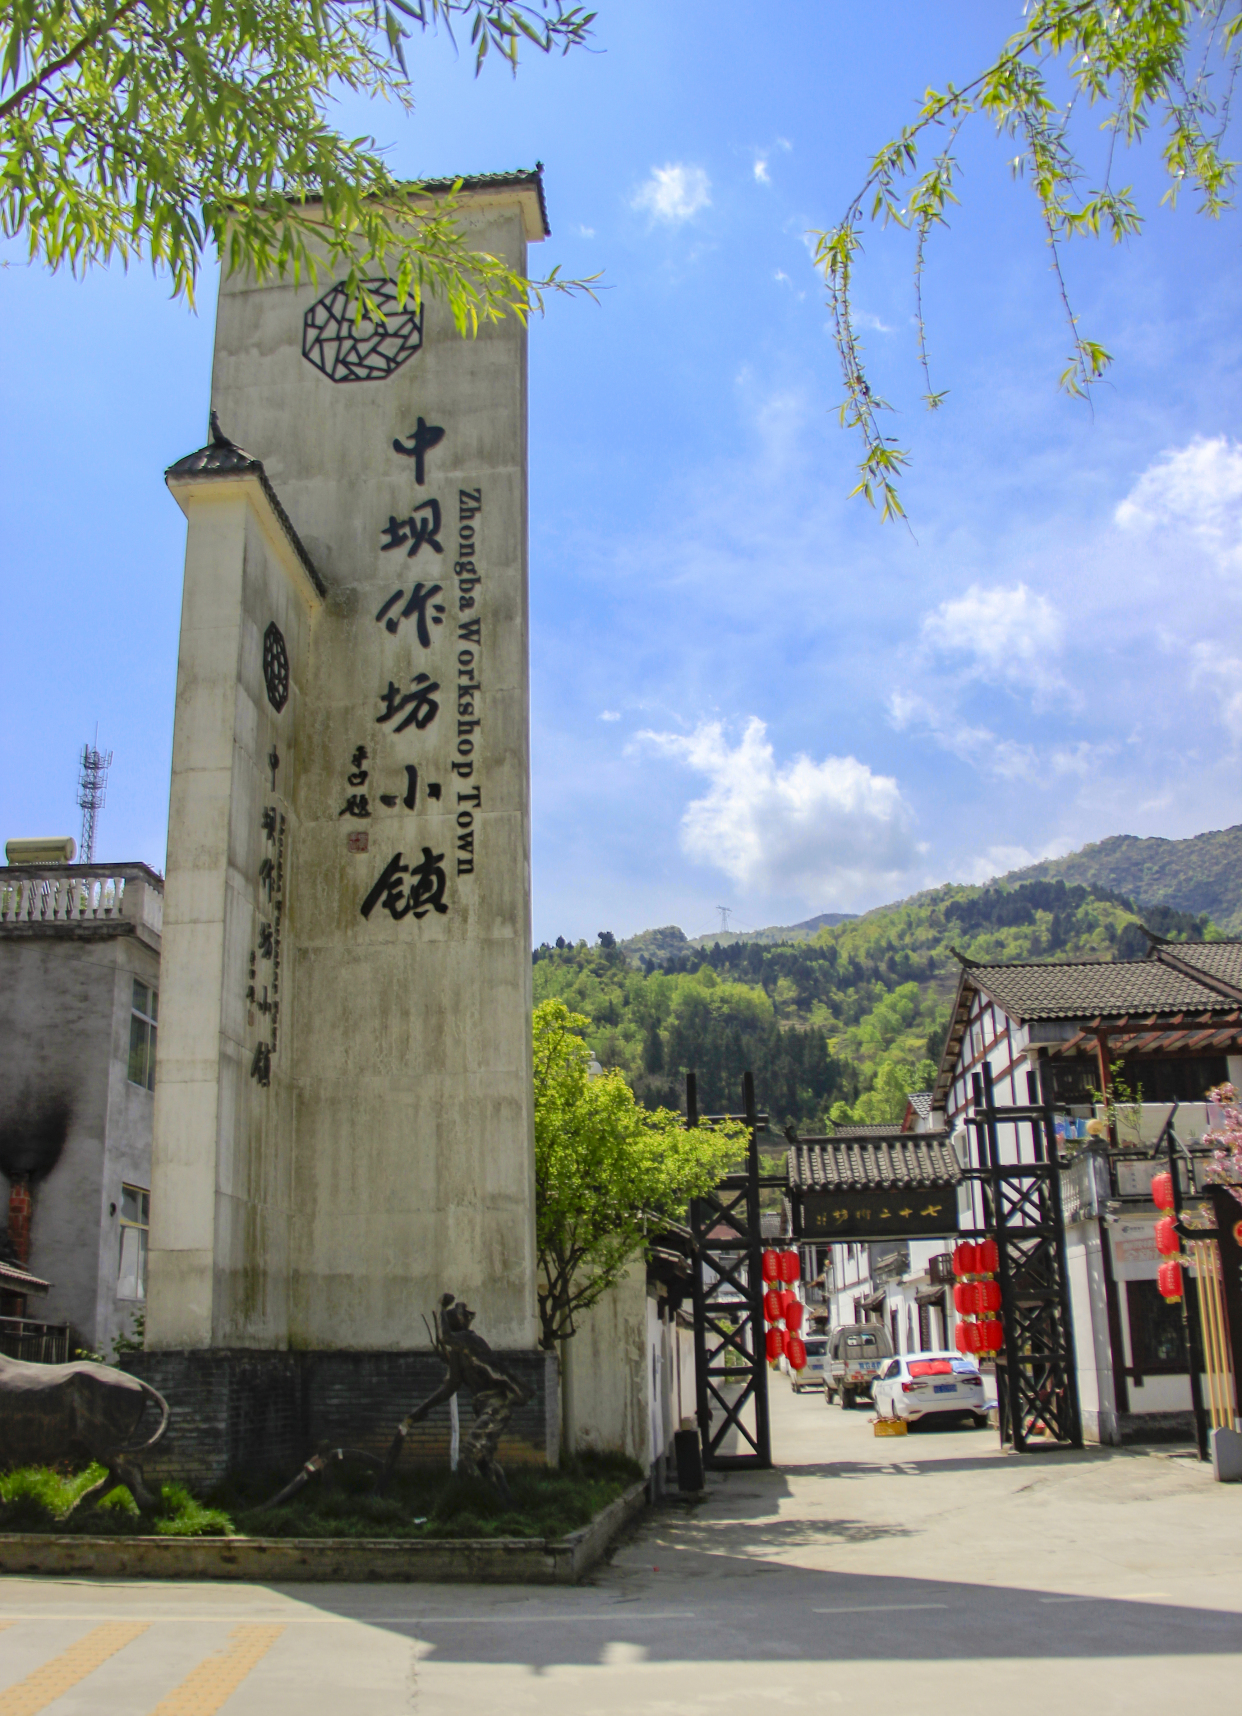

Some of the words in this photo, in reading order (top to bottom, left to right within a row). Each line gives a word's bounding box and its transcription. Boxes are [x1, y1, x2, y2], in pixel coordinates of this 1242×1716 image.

[453, 487, 482, 613] Zhongba
[360, 416, 449, 921] 中坝作坊小镇
[451, 616, 482, 780] Workshop
[456, 785, 482, 878] Town
